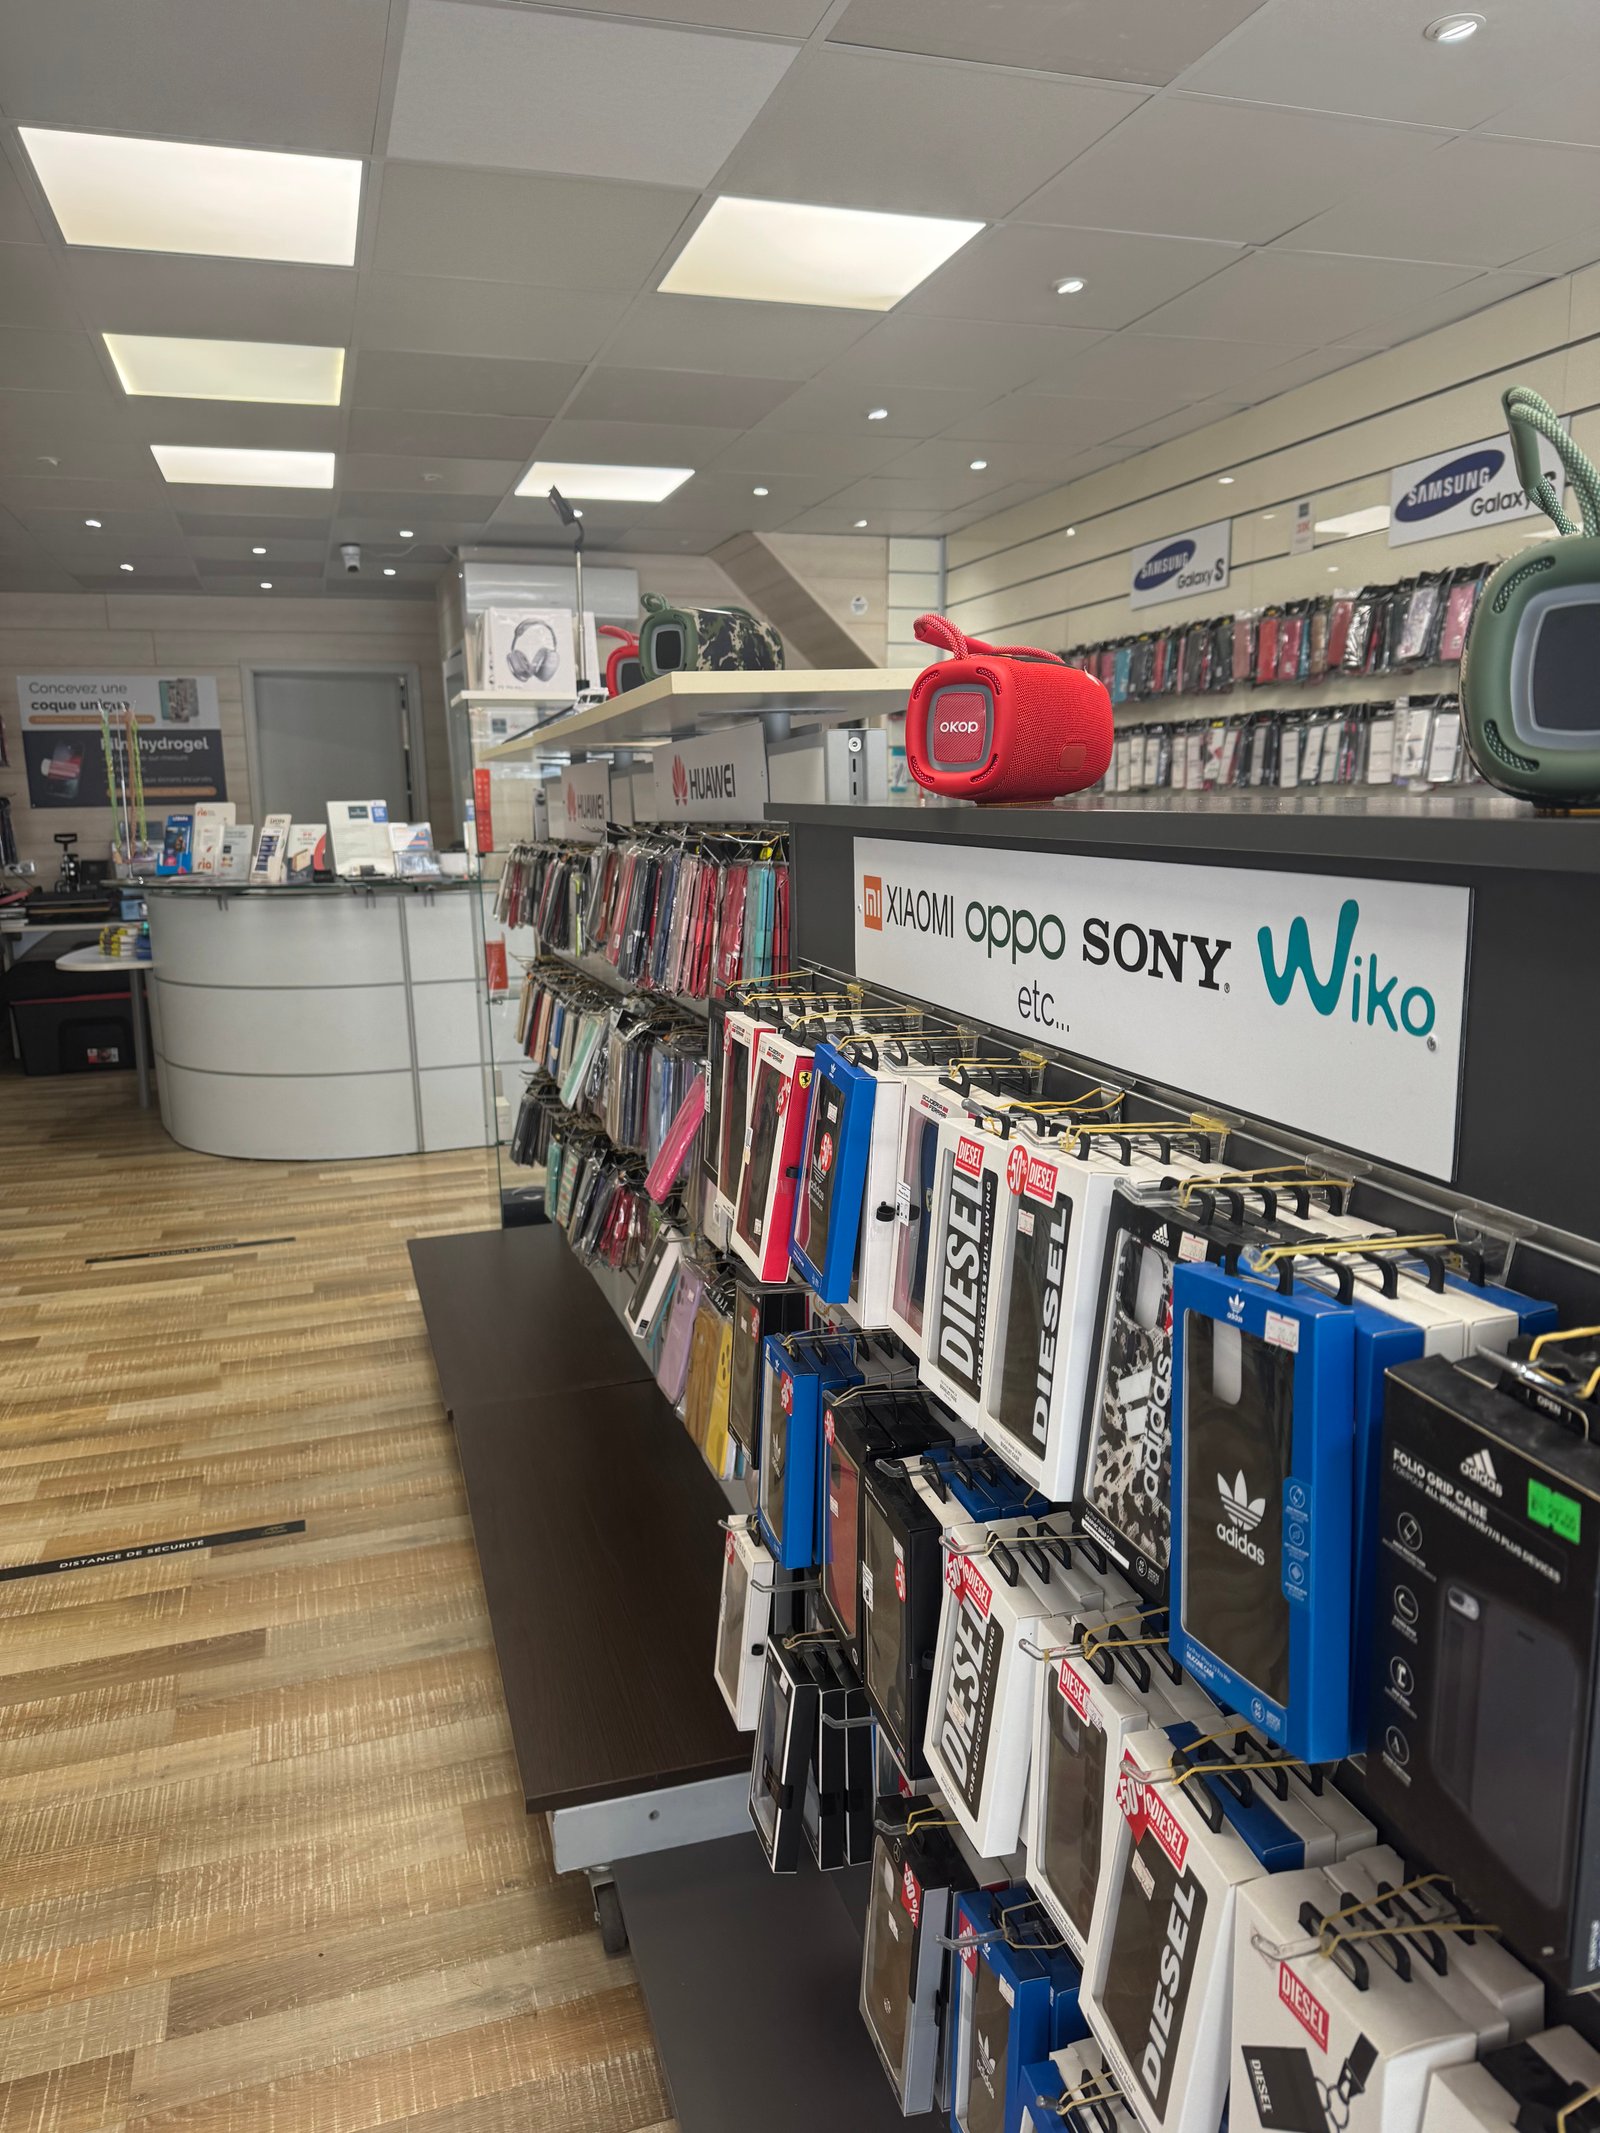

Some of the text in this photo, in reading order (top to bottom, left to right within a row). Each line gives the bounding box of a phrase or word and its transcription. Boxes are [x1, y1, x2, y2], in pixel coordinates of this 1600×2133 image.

[1406, 465, 1490, 507] SAMSUNG
[1141, 552, 1189, 579] SAMSUNG
[1177, 558, 1225, 589] Galaxy S
[29, 682, 128, 694] Concevez une
[31, 701, 77, 712] coque
[139, 737, 209, 753] hydrogel
[688, 763, 736, 800] HUAWEI
[577, 793, 604, 820] HUAWEI
[886, 884, 954, 938] XIAOMI
[965, 901, 1066, 965] oppo
[1082, 918, 1231, 990] SONY
[1257, 899, 1436, 1037] Wiko
[958, 1141, 981, 1168] DIESEL
[1008, 1149, 1028, 1191] -50%
[1028, 1163, 1055, 1193] DIESEL
[983, 1181, 991, 1236] LIVING
[1152, 1233, 1169, 1248] adidas
[940, 1174, 983, 1381] DIESEL
[979, 1243, 989, 1349] SUCCESSFUL
[1033, 1208, 1068, 1445] DIESEL
[1143, 1353, 1171, 1499] adidas
[1537, 1395, 1561, 1416] OPEN
[1393, 1448, 1488, 1521] FOLIO GRIP CASE
[1424, 1485, 1439, 1501] ALL
[1460, 1461, 1503, 1498] adidas
[59, 1554, 121, 1568] DISTANCE
[126, 1550, 143, 1558] DE
[1217, 1520, 1265, 1566] adidas
[968, 1568, 989, 1608] DIESEL
[941, 1603, 988, 1789] DIESEL
[1061, 1663, 1087, 1711] DIESEL
[968, 1627, 995, 1802] FOR SUCCESSFUL LIVING
[1151, 1797, 1183, 1859] DIESEL
[1141, 1882, 1196, 2100] DIESEL
[1282, 1967, 1325, 2040] DIESEL
[1251, 2058, 1273, 2114] DIESEL
